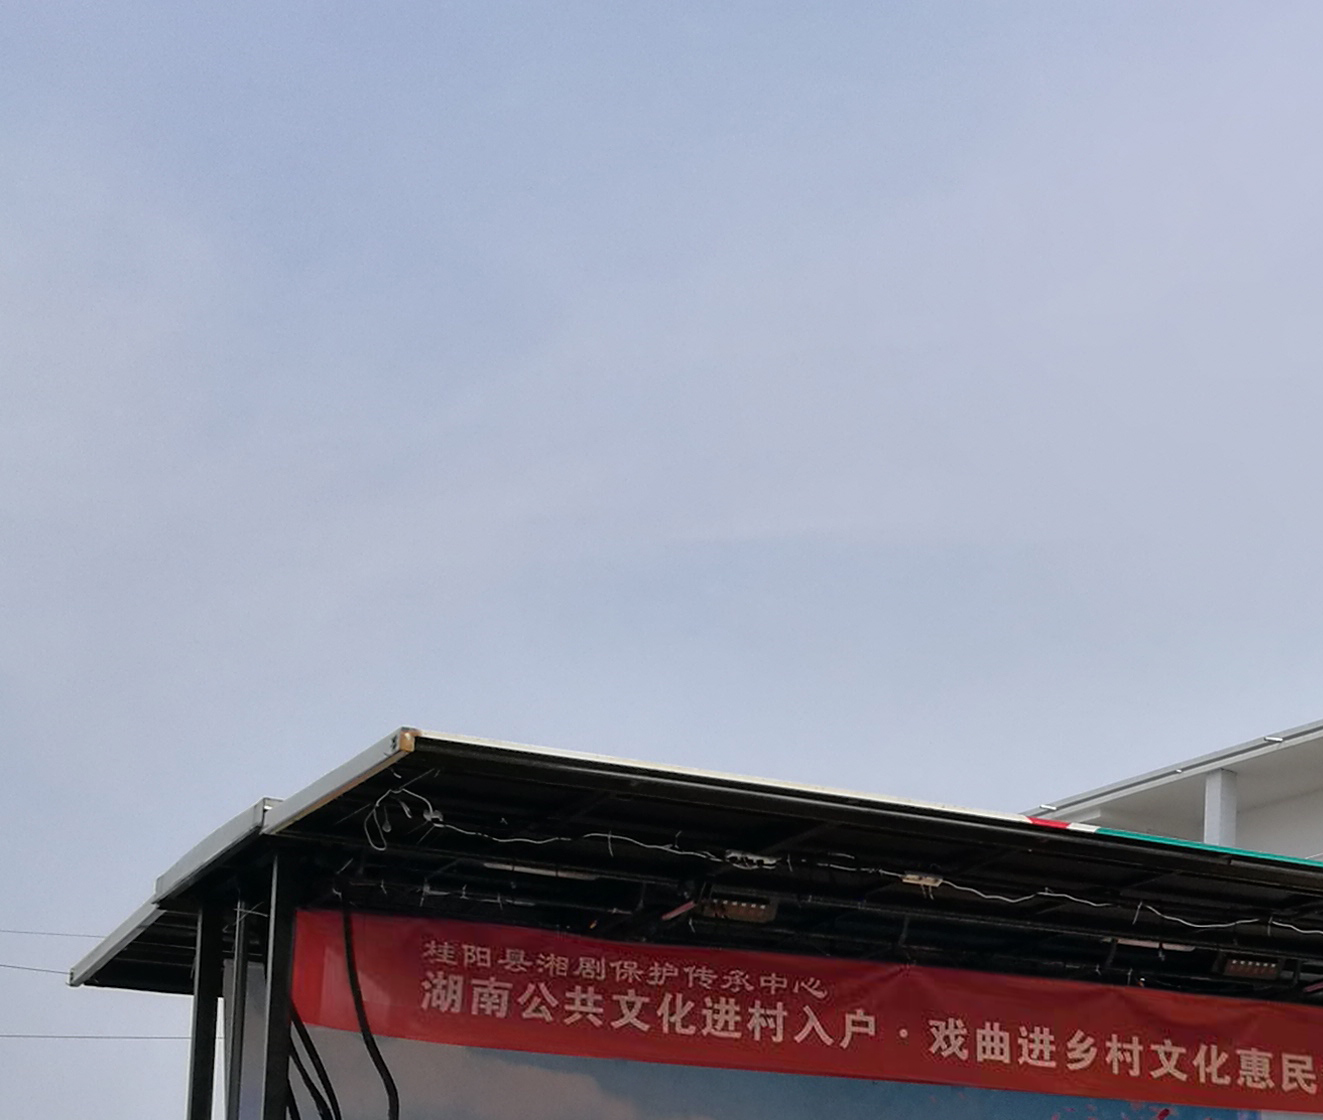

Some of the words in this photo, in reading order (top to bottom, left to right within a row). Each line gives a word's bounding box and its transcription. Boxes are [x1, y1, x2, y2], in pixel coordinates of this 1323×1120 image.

[423, 941, 828, 999] 桂阳县湘剧保护传承中心
